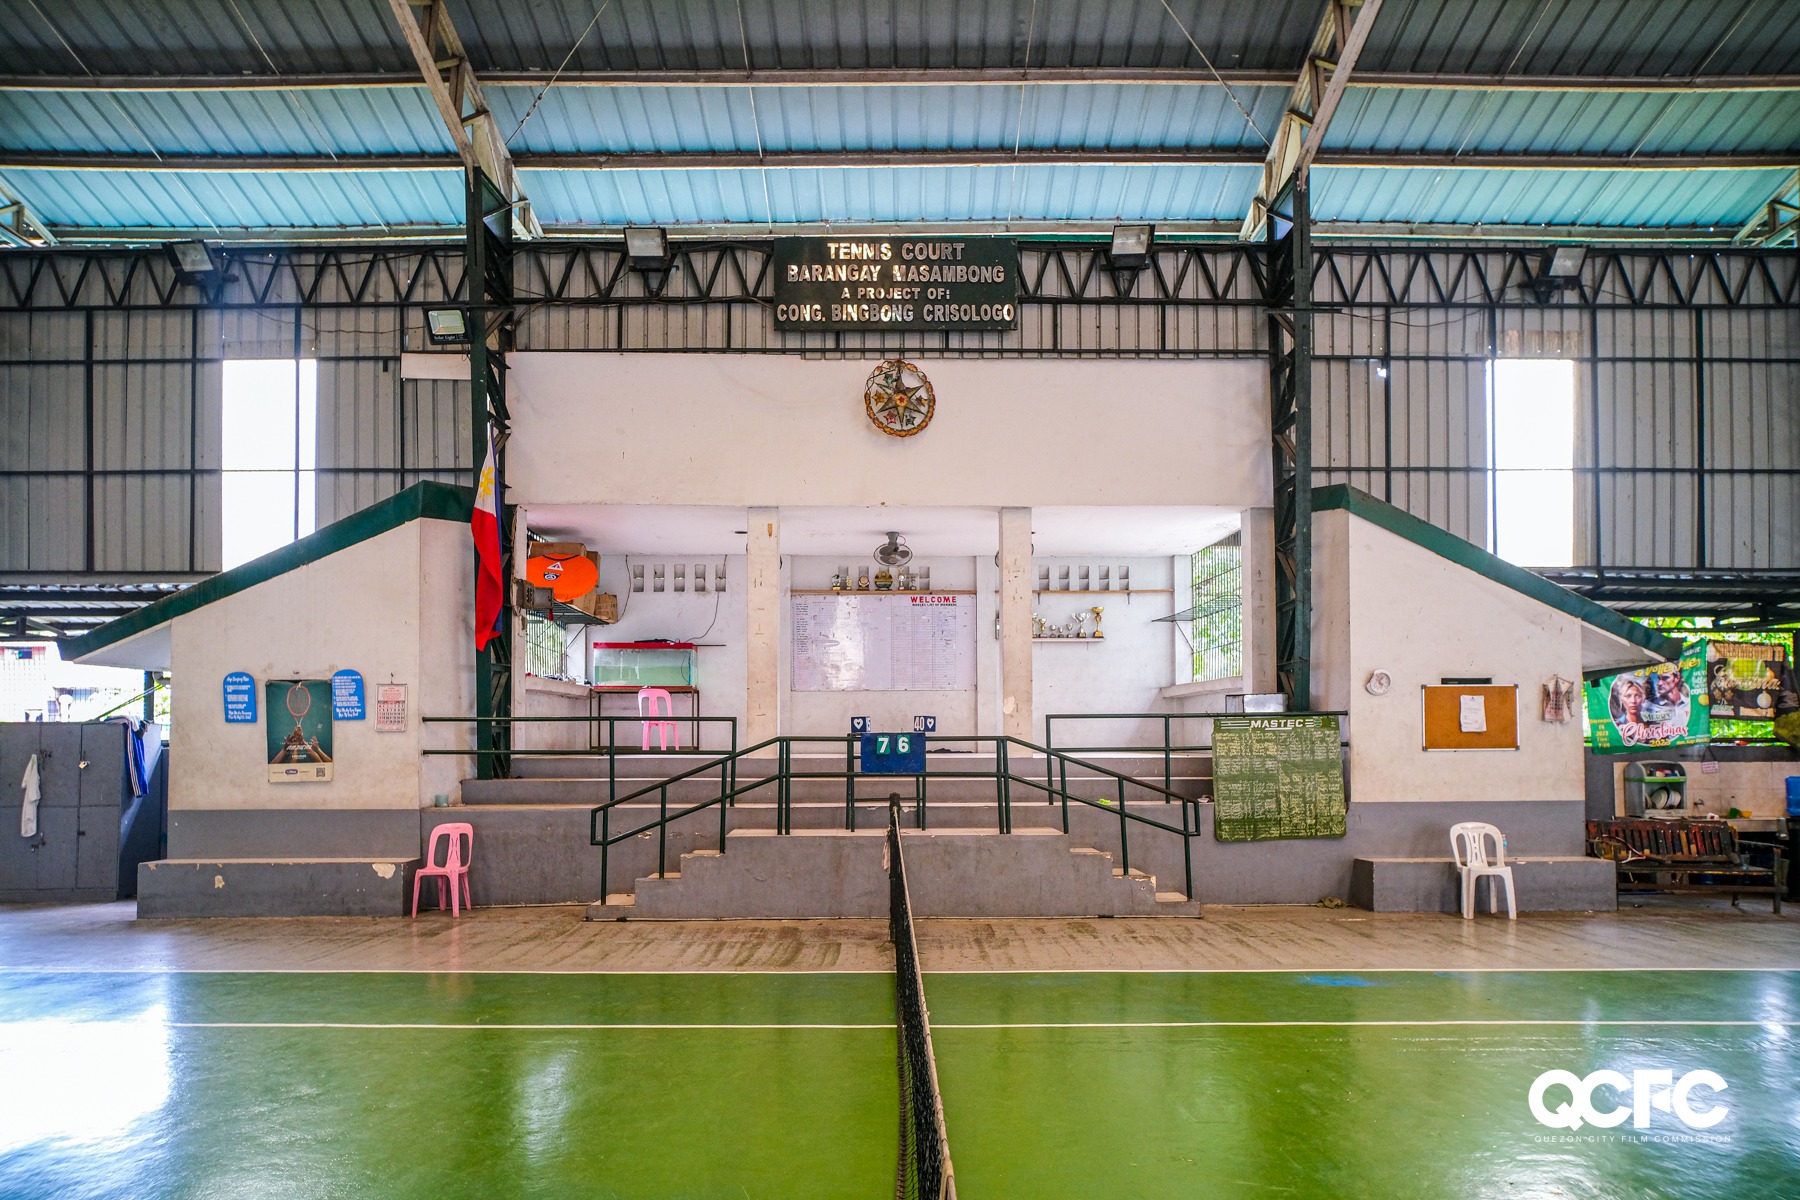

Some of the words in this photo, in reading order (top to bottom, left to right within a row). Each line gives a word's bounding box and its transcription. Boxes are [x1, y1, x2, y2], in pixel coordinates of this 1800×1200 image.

[827, 243, 892, 260] TENNIS
[901, 243, 965, 260] COURT
[787, 264, 882, 282] BARANGAY
[893, 265, 1005, 283] MASAMBONG
[841, 287, 851, 299] A
[857, 287, 920, 299] PROJECT
[927, 287, 951, 299] OF:
[776, 304, 826, 322] CONG.
[831, 304, 914, 322] BINGBONG
[923, 304, 1015, 322] CRISOLOGO
[914, 716, 925, 731] 40
[1251, 719, 1304, 728] MASTEC
[1620, 722, 1689, 747] Christmas
[878, 738, 889, 753] 7
[898, 737, 909, 752] 6
[1650, 739, 1671, 747] 2023
